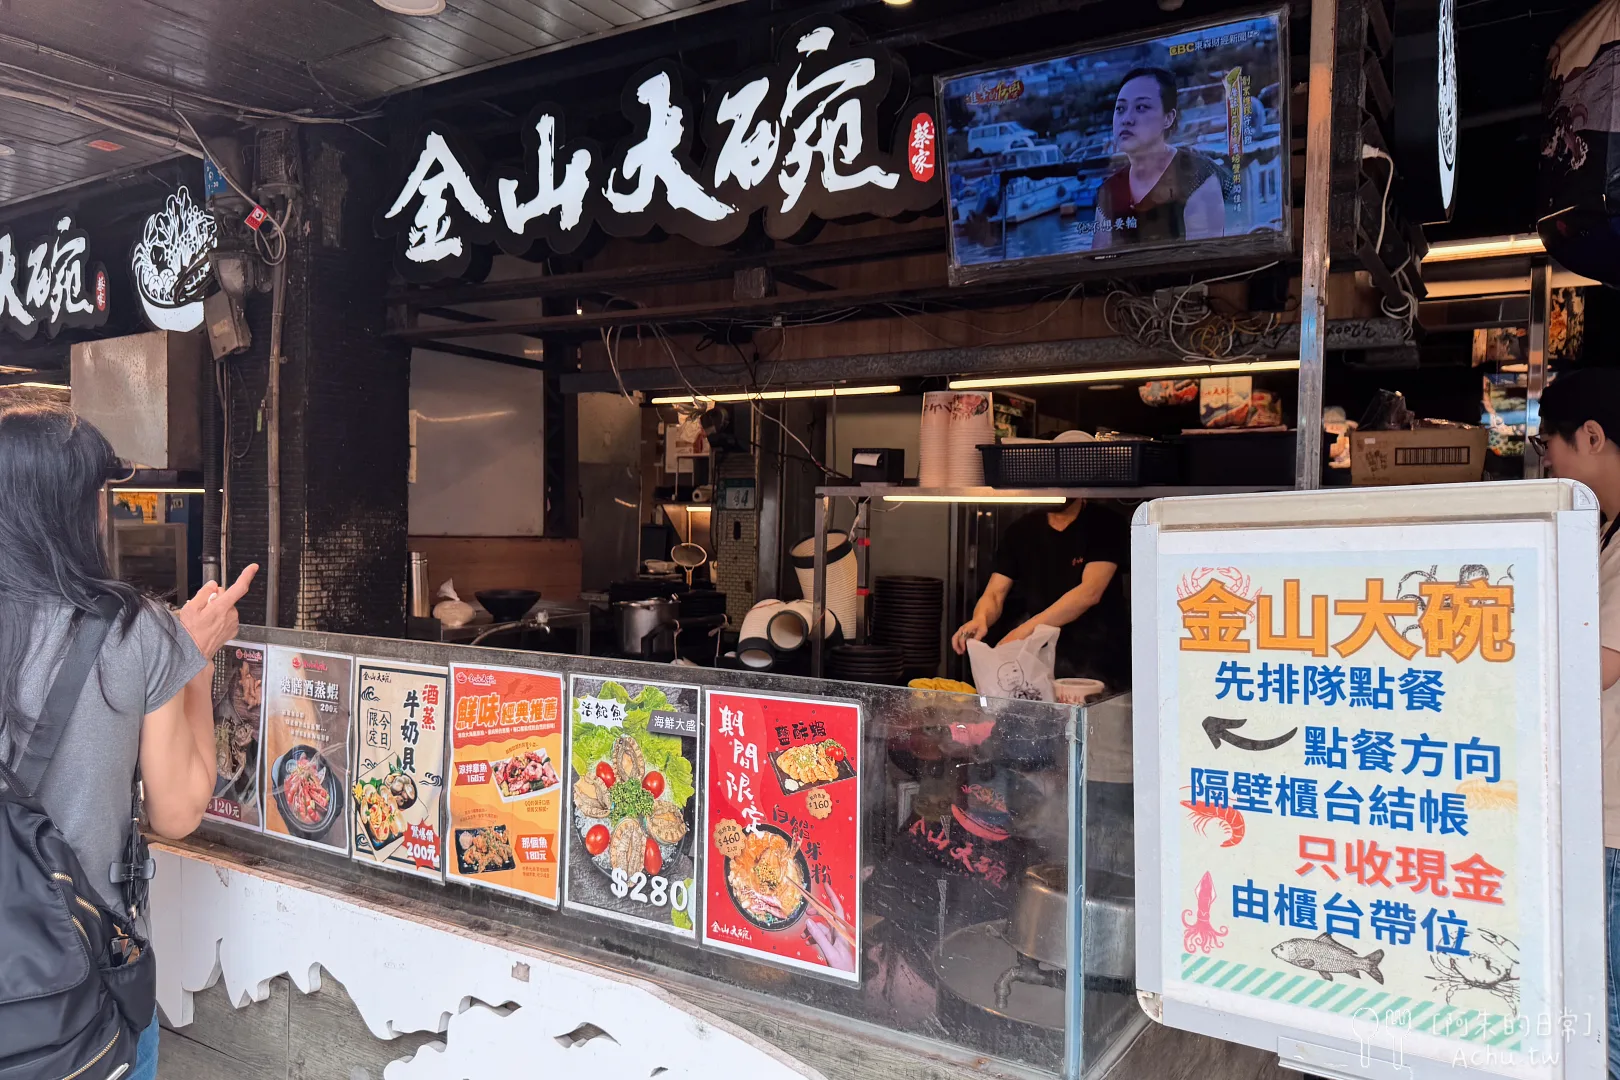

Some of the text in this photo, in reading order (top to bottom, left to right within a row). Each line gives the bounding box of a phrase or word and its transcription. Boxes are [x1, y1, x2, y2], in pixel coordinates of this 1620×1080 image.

[385, 27, 899, 262] 金山大碗
[911, 121, 934, 175] 蔡家
[1177, 577, 1515, 662] 金山大碗
[422, 684, 439, 730] 酒蒸
[455, 692, 558, 730] 鮮味 經典推薦
[581, 701, 623, 721] 活鮑魚
[1214, 661, 1446, 712] 先排隊點餐
[400, 689, 420, 773] 牛奶貝
[654, 715, 697, 732] 海鮮大盛
[718, 705, 765, 838] 期間限定
[1304, 726, 1501, 783] 點餐方向
[1190, 768, 1469, 836] 隔壁櫃台結帳
[406, 842, 440, 863] 200元
[521, 837, 548, 849] 那個魚
[718, 832, 740, 847] $460
[610, 867, 688, 911] $280
[1295, 835, 1505, 904] 只收現金
[711, 920, 752, 940] 金山大碗
[1231, 879, 1471, 956] 由櫃台帶位
